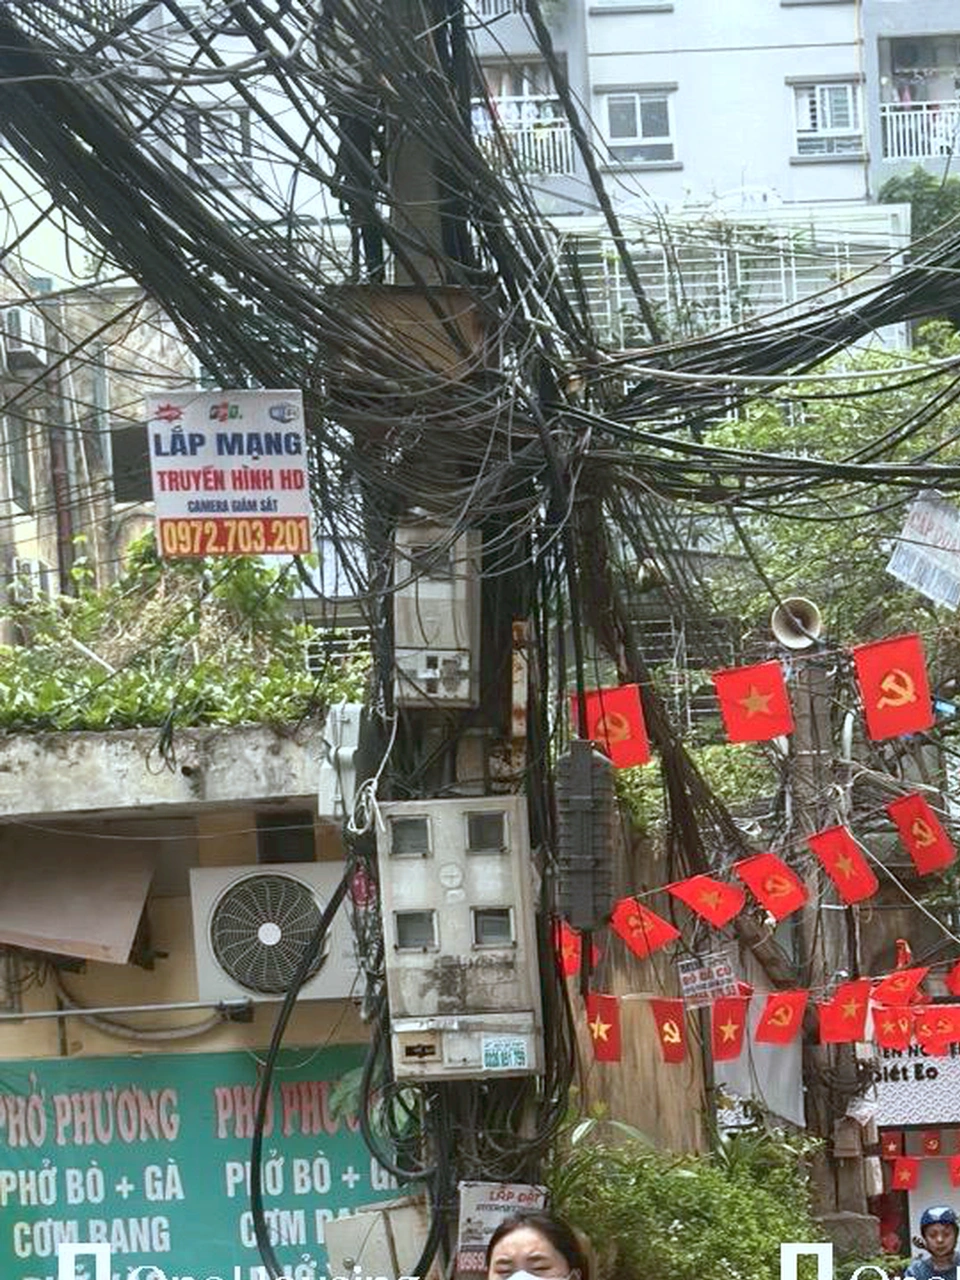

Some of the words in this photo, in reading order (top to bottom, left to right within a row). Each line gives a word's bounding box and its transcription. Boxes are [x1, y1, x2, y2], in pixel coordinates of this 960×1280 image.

[216, 431, 302, 460] MẠNG
[231, 464, 274, 491] HÌNH
[280, 469, 304, 490] HD
[163, 520, 309, 554] 0972.703.201
[0, 1158, 57, 1206] PHỞ
[65, 1160, 105, 1204] BÒ
[144, 1158, 185, 1201] GÀ
[293, 1150, 331, 1194] BÒ
